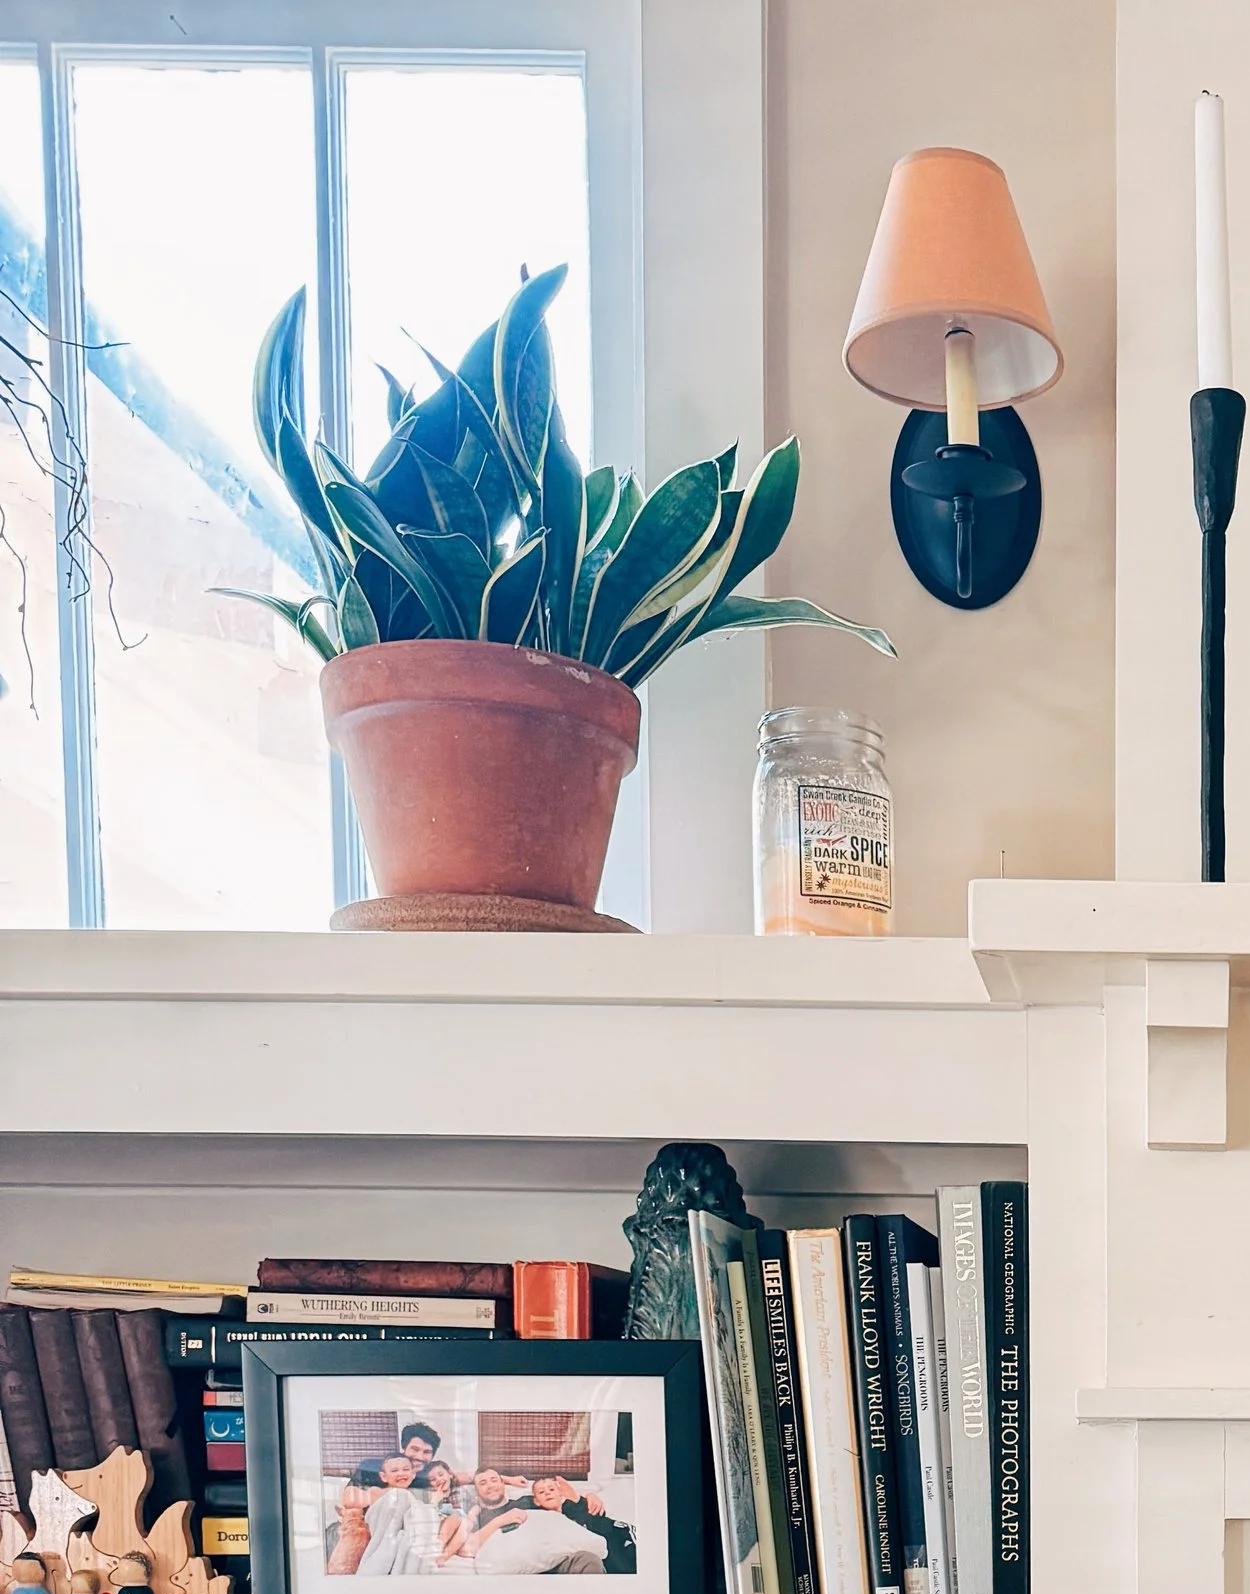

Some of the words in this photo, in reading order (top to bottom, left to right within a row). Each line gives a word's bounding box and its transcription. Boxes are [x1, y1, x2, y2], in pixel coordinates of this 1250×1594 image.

[803, 789, 824, 800] Swan
[826, 791, 847, 802] Creek
[849, 794, 871, 806] Candle
[803, 801, 839, 822] EXOTIC
[804, 821, 837, 836] rich
[858, 806, 881, 824] deep
[813, 860, 862, 877] warm
[814, 847, 848, 860] DARK
[850, 835, 888, 869] SPICE
[809, 898, 831, 906] Spiced
[834, 899, 856, 909] Orange
[887, 1231, 896, 1246] ALL
[1003, 1202, 1014, 1260] NATIONAL
[889, 1246, 898, 1263] THE
[764, 1261, 782, 1295] LIFE
[856, 1241, 875, 1303] FRANK
[301, 1298, 368, 1313] WUTHERING
[371, 1300, 419, 1313] HEIGHTS
[1004, 1262, 1015, 1335] GEOGRAPHIC
[339, 1312, 357, 1321] Emily
[769, 1299, 787, 1357] SMILES
[893, 1300, 904, 1336] ANIMALS
[861, 1309, 880, 1369] LLOYD
[915, 1336, 924, 1354] THE
[775, 1361, 792, 1407] BACK
[917, 1356, 929, 1412] PENGROOMS
[1001, 1345, 1019, 1391] THE
[896, 1355, 913, 1436] SONGBIRDS
[939, 1358, 950, 1413] PENGROOMS
[961, 1362, 984, 1439] WORLD
[866, 1376, 887, 1452] WRIGHT
[783, 1423, 793, 1451] Philip
[786, 1453, 796, 1463] B.
[925, 1466, 933, 1480] Paul
[788, 1466, 802, 1513] Kunhardt,
[1001, 1400, 1019, 1561] PHOTOGRAPHS
[874, 1474, 888, 1529] CAROLINE
[791, 1515, 803, 1529] Jr.
[879, 1532, 892, 1574] KNIGHT
